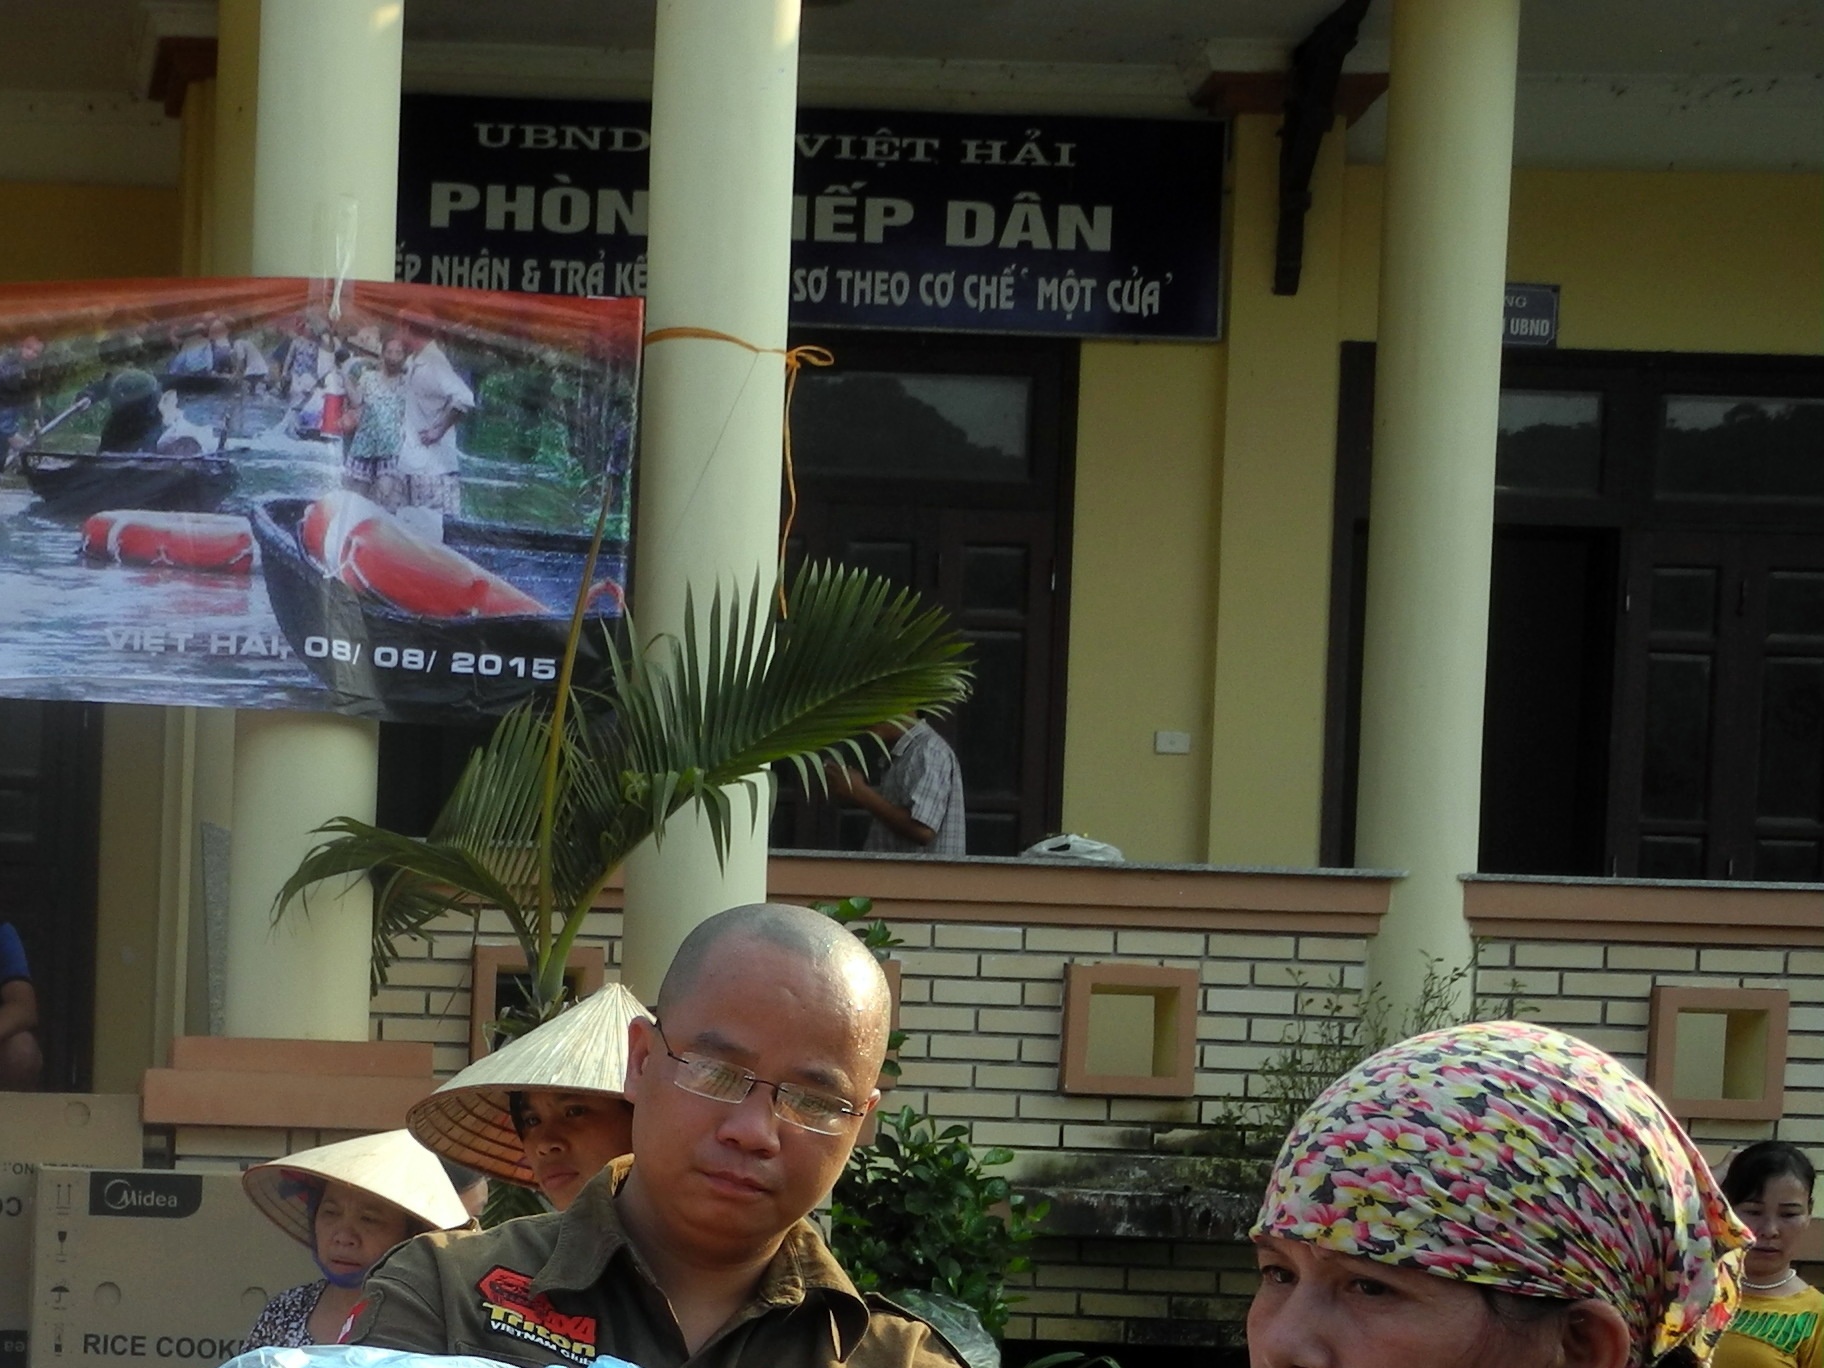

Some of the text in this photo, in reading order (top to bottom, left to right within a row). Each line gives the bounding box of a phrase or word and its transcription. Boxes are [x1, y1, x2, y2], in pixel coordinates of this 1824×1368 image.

[473, 122, 1076, 169] UBND VIỆT HẢI
[429, 173, 1114, 252] PHÒN IẾP DÂN
[521, 259, 541, 293] &
[835, 268, 911, 308] THEO
[919, 269, 956, 308] CƠ
[963, 263, 1017, 312] CHẾ
[1509, 317, 1550, 337] UBND
[449, 650, 558, 681] 2015
[116, 1186, 178, 1208] Midea
[482, 1301, 596, 1358] Triton
[490, 1320, 558, 1352] VIETNAM
[83, 1333, 244, 1360] RICE COOK
